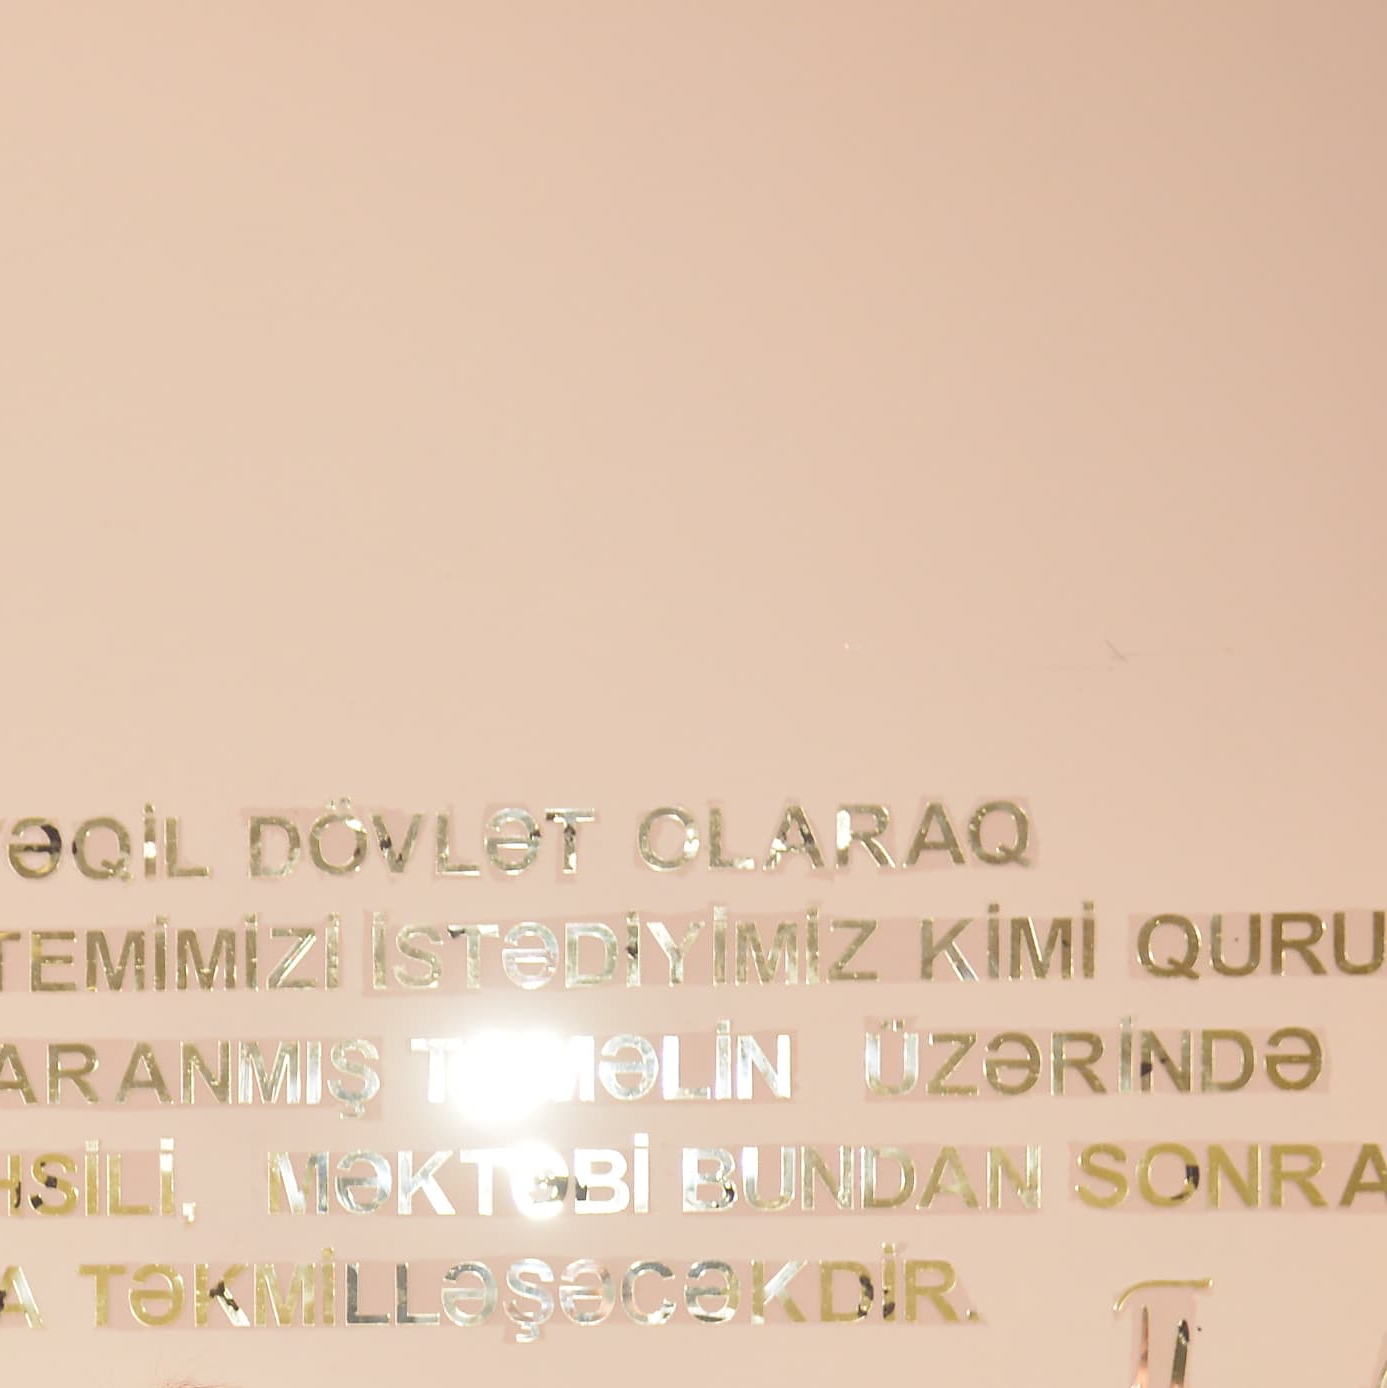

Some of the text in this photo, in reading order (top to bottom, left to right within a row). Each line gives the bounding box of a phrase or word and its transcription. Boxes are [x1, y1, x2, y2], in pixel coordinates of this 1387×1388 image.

[248, 797, 596, 879] DÖVLƏT
[637, 800, 1032, 870] OLARAQ
[370, 904, 879, 990] İSTƏDİYİMİZ
[920, 902, 1096, 984] KİMİ
[410, 1018, 791, 1102] TMƏLİN
[864, 1017, 1324, 1098] ÜZƏRİNDƏ
[681, 1145, 1042, 1214] BUNDAN
